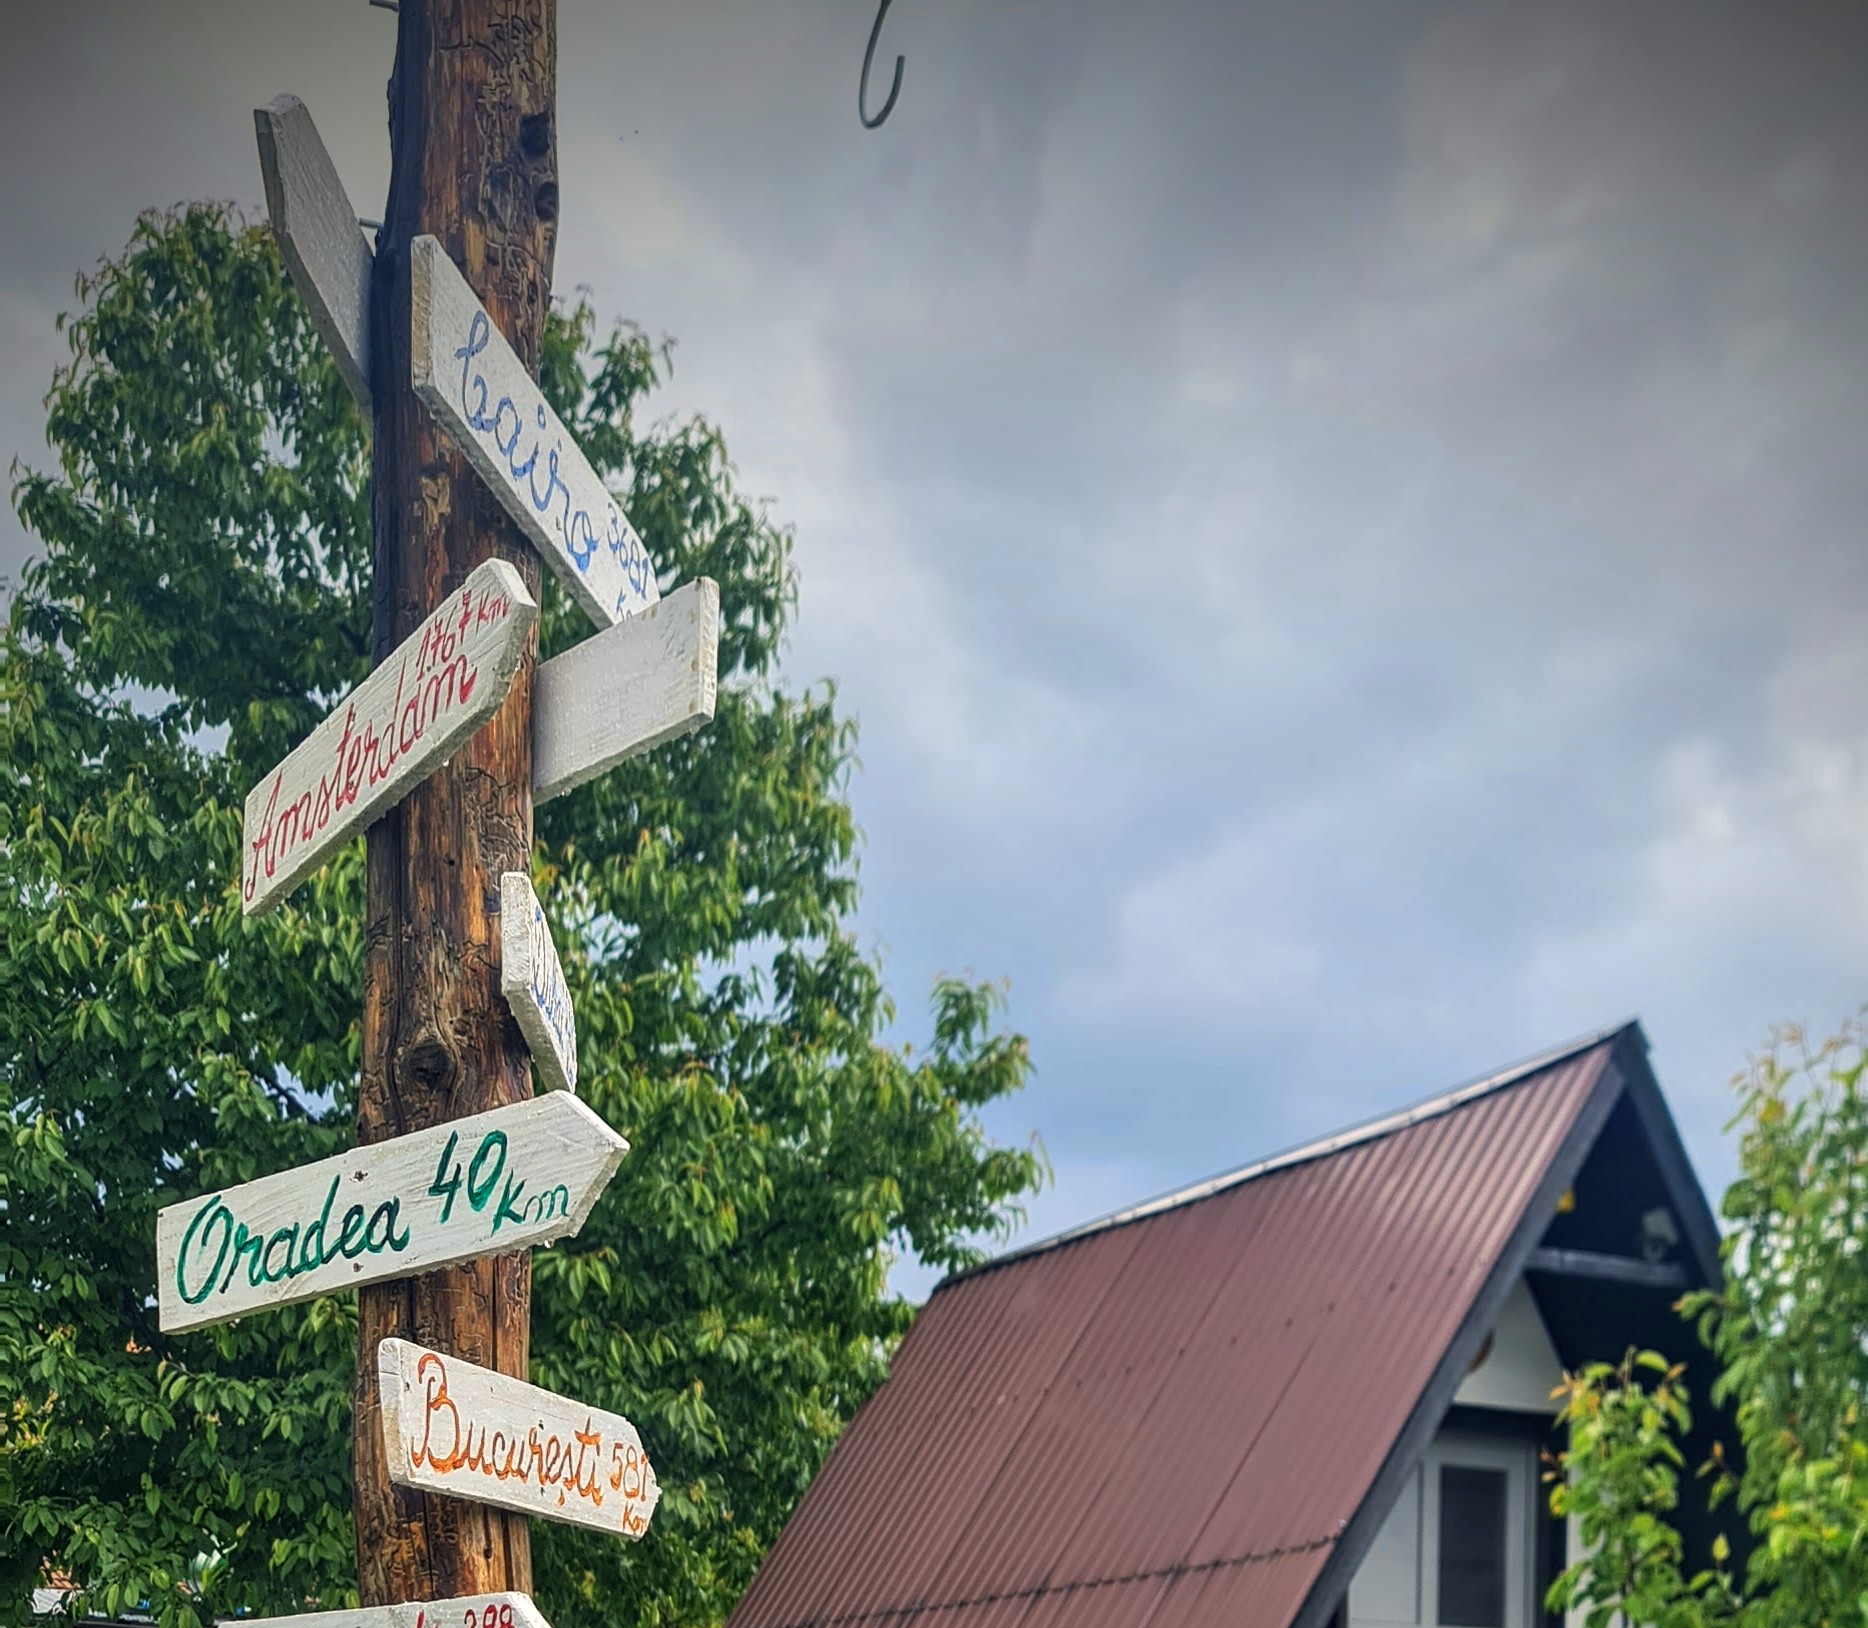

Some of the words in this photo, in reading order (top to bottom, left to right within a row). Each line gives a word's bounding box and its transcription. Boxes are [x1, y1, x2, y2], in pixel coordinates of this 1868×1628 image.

[416, 590, 471, 681] 1767
[245, 654, 478, 903] Amsterdam
[176, 1174, 411, 1305] Oradea
[428, 1129, 508, 1224] 40
